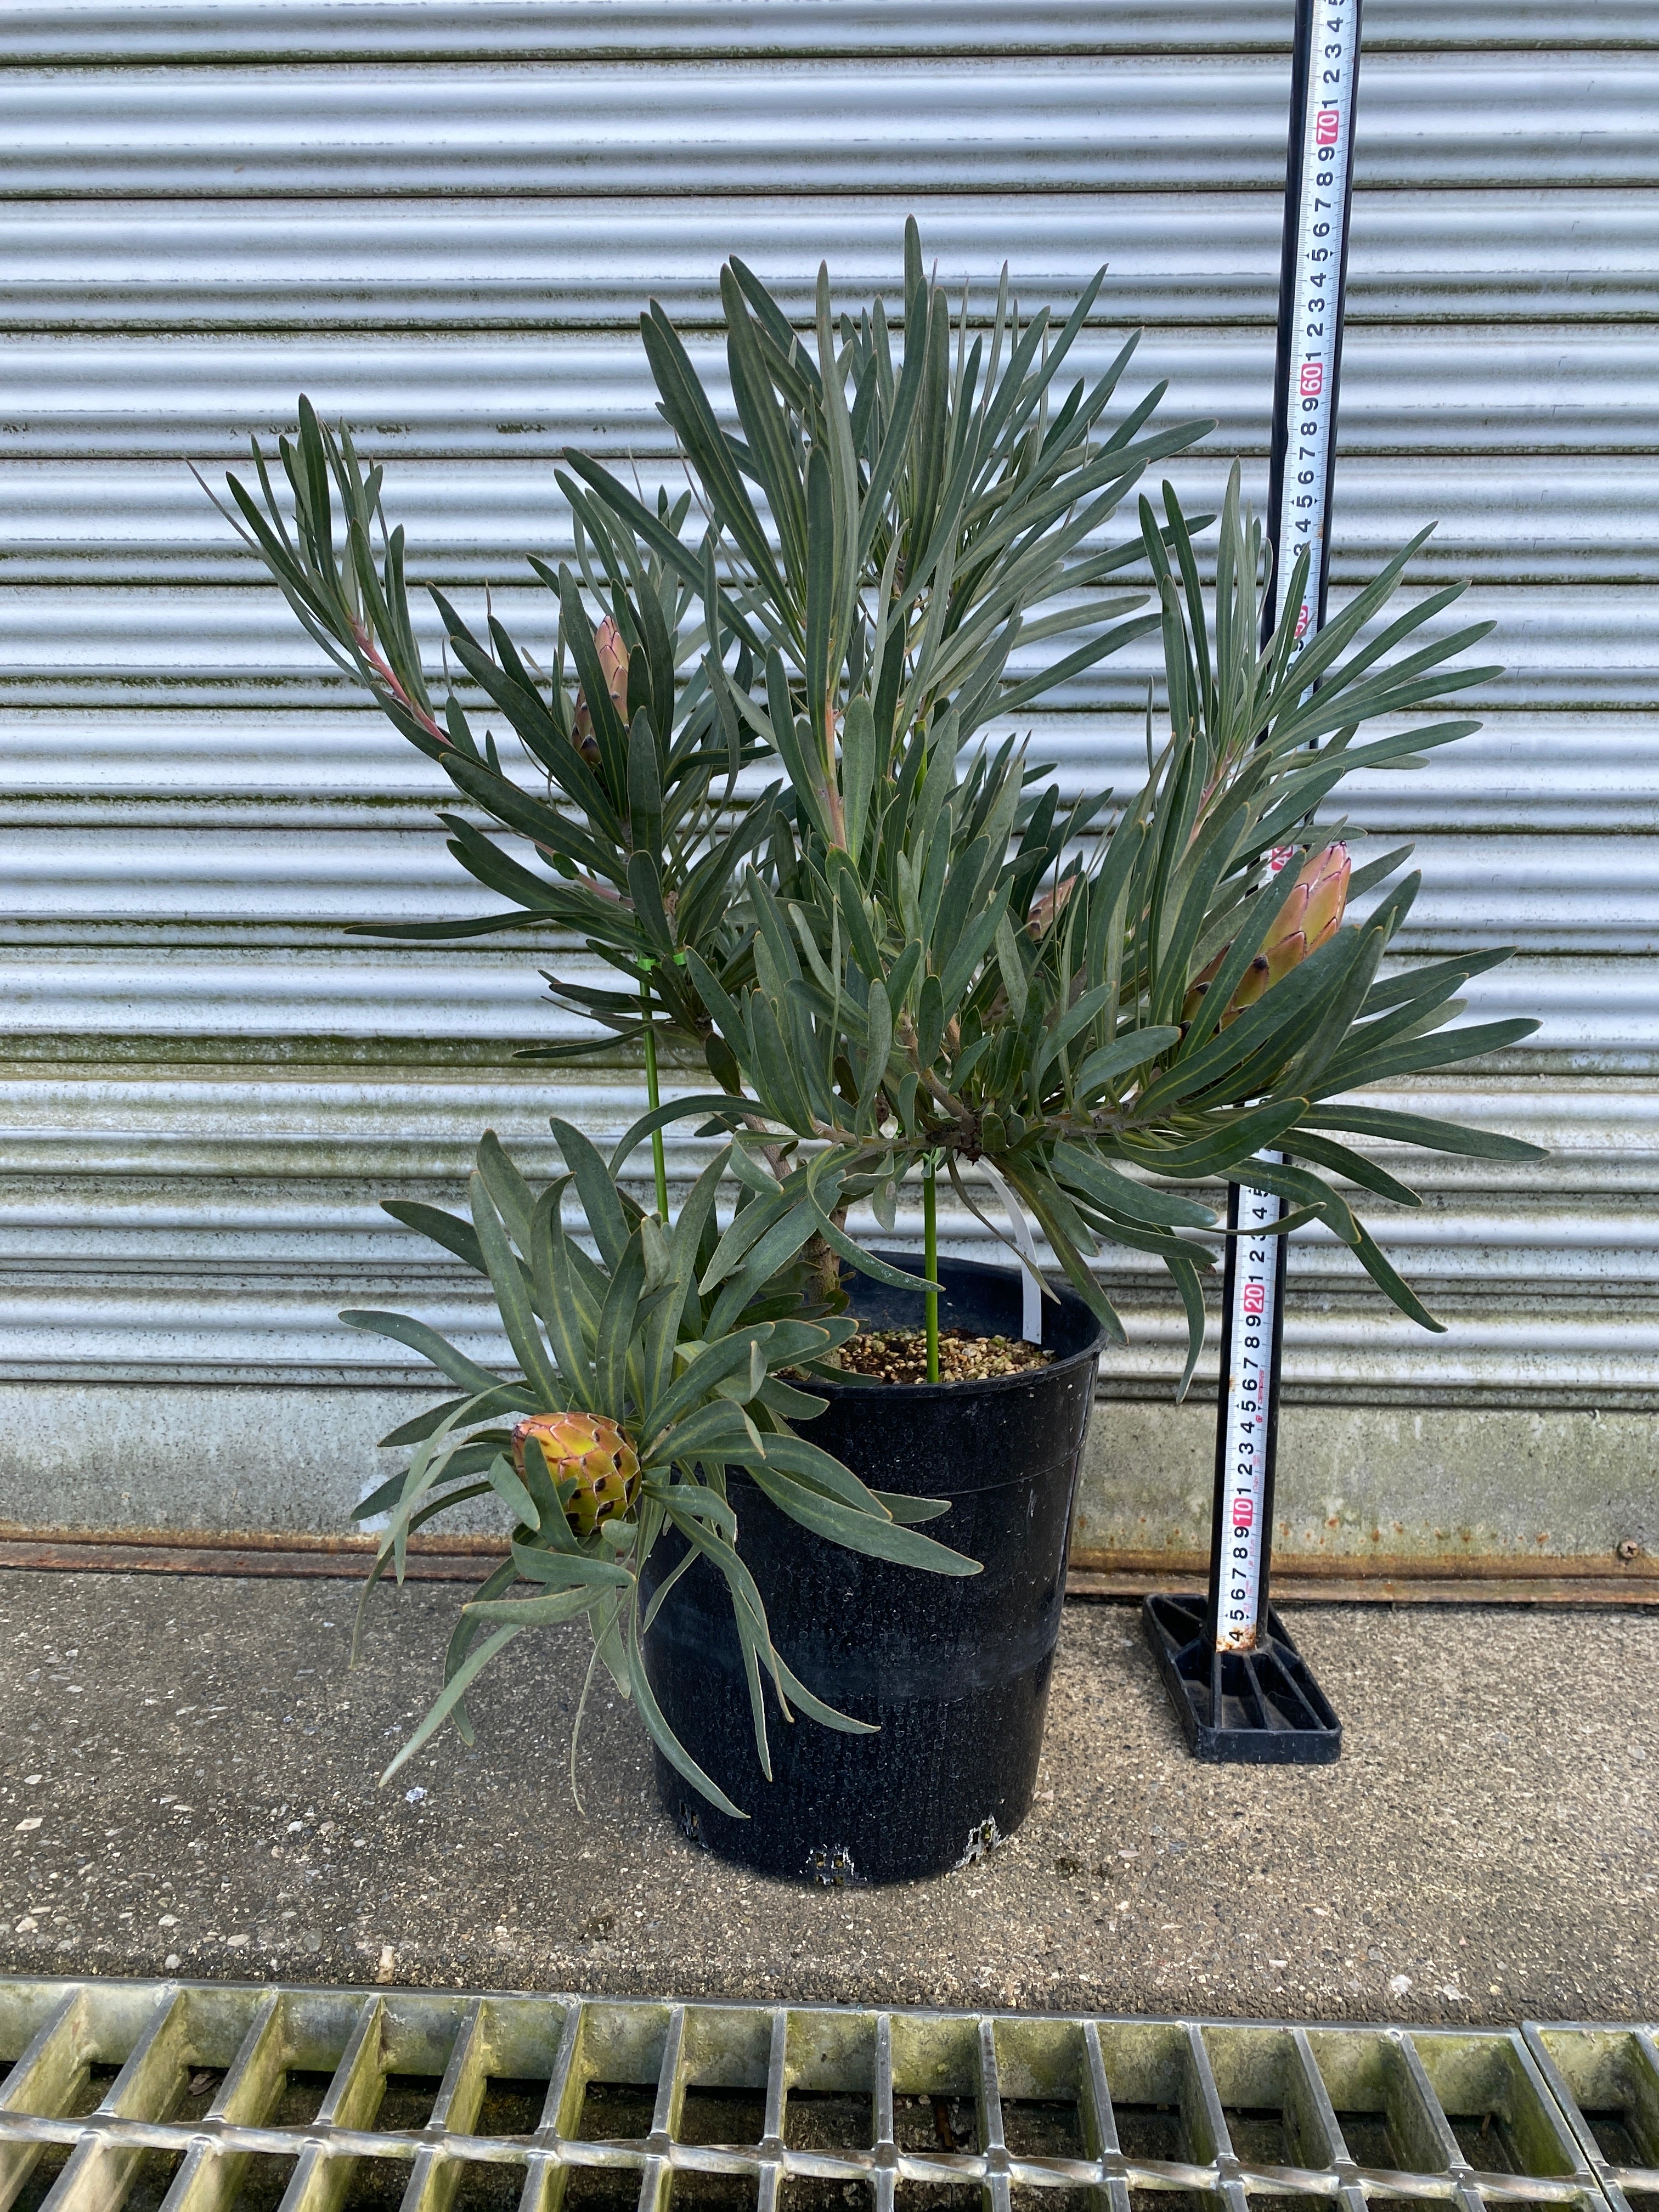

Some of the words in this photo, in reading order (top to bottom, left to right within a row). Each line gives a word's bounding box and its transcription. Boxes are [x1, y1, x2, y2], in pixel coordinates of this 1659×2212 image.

[1327, 17, 1343, 32] 4
[1325, 43, 1341, 58] 3
[1323, 69, 1340, 83] 2
[1322, 99, 1338, 109] 1
[1318, 114, 1338, 142] 70
[1318, 148, 1335, 162] 9
[1316, 172, 1333, 187] 8
[1314, 198, 1331, 212] 7
[1313, 223, 1330, 237] 6
[1311, 248, 1328, 262] 5
[1310, 273, 1327, 288] 4
[1308, 298, 1325, 313] 3
[1306, 323, 1323, 337] 2
[1305, 352, 1322, 362] 1
[1302, 368, 1321, 392] 60
[1302, 398, 1318, 411] 9
[1300, 421, 1317, 436] 8
[1299, 447, 1315, 460] 7
[1297, 470, 1314, 485] 6
[1296, 495, 1313, 509] 5
[1295, 518, 1312, 533] 4
[1252, 1206, 1267, 1220] 4
[1249, 1250, 1265, 1263] 2
[1246, 1286, 1263, 1310] 20
[1245, 1314, 1261, 1327] 9
[1244, 1336, 1260, 1349] 8
[1243, 1357, 1258, 1369] 7
[1242, 1379, 1257, 1391] 6
[1241, 1400, 1256, 1413] 5
[1240, 1421, 1255, 1434] 4
[1239, 1442, 1254, 1455] 3
[1237, 1463, 1252, 1476] 2
[1234, 1500, 1252, 1521] 10
[1234, 1526, 1249, 1538] 9
[1233, 1547, 1248, 1560] 8
[1232, 1567, 1246, 1579] 7
[1231, 1588, 1245, 1600] 6
[1230, 1609, 1244, 1621] 5
[1229, 1630, 1244, 1643] 4
